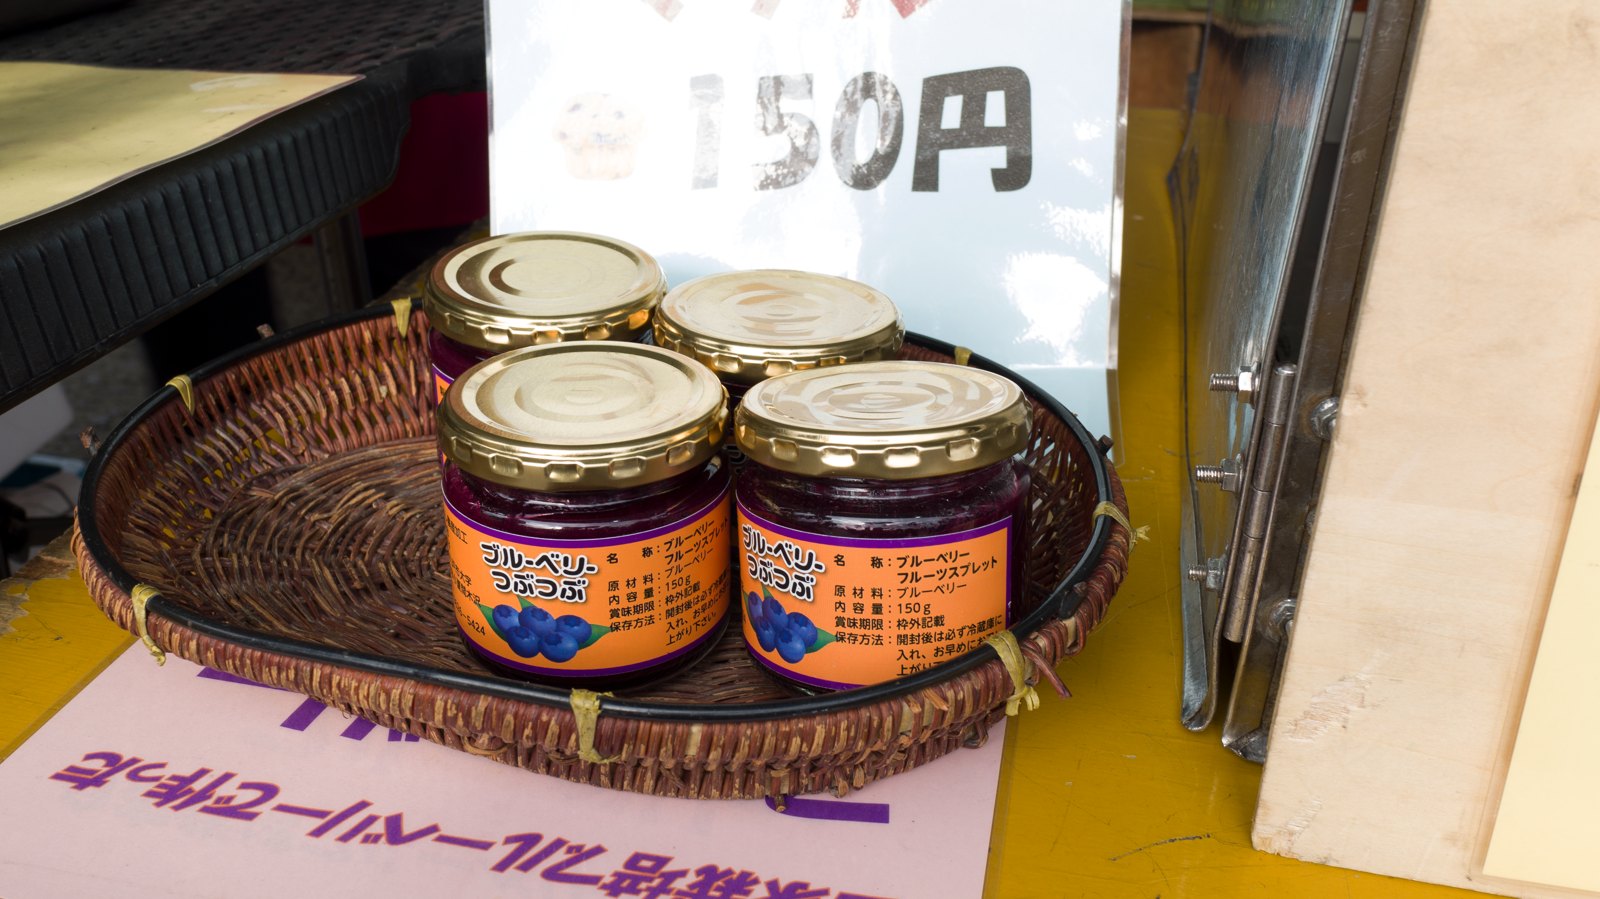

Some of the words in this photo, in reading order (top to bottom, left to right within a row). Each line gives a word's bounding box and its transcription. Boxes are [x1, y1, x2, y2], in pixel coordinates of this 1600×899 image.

[690, 65, 1033, 193] 150円
[480, 542, 599, 577] ブルーベリー
[742, 525, 826, 573] ブルーベリー
[491, 570, 590, 604] つぶつぶ
[746, 554, 818, 602] つぶつぶ
